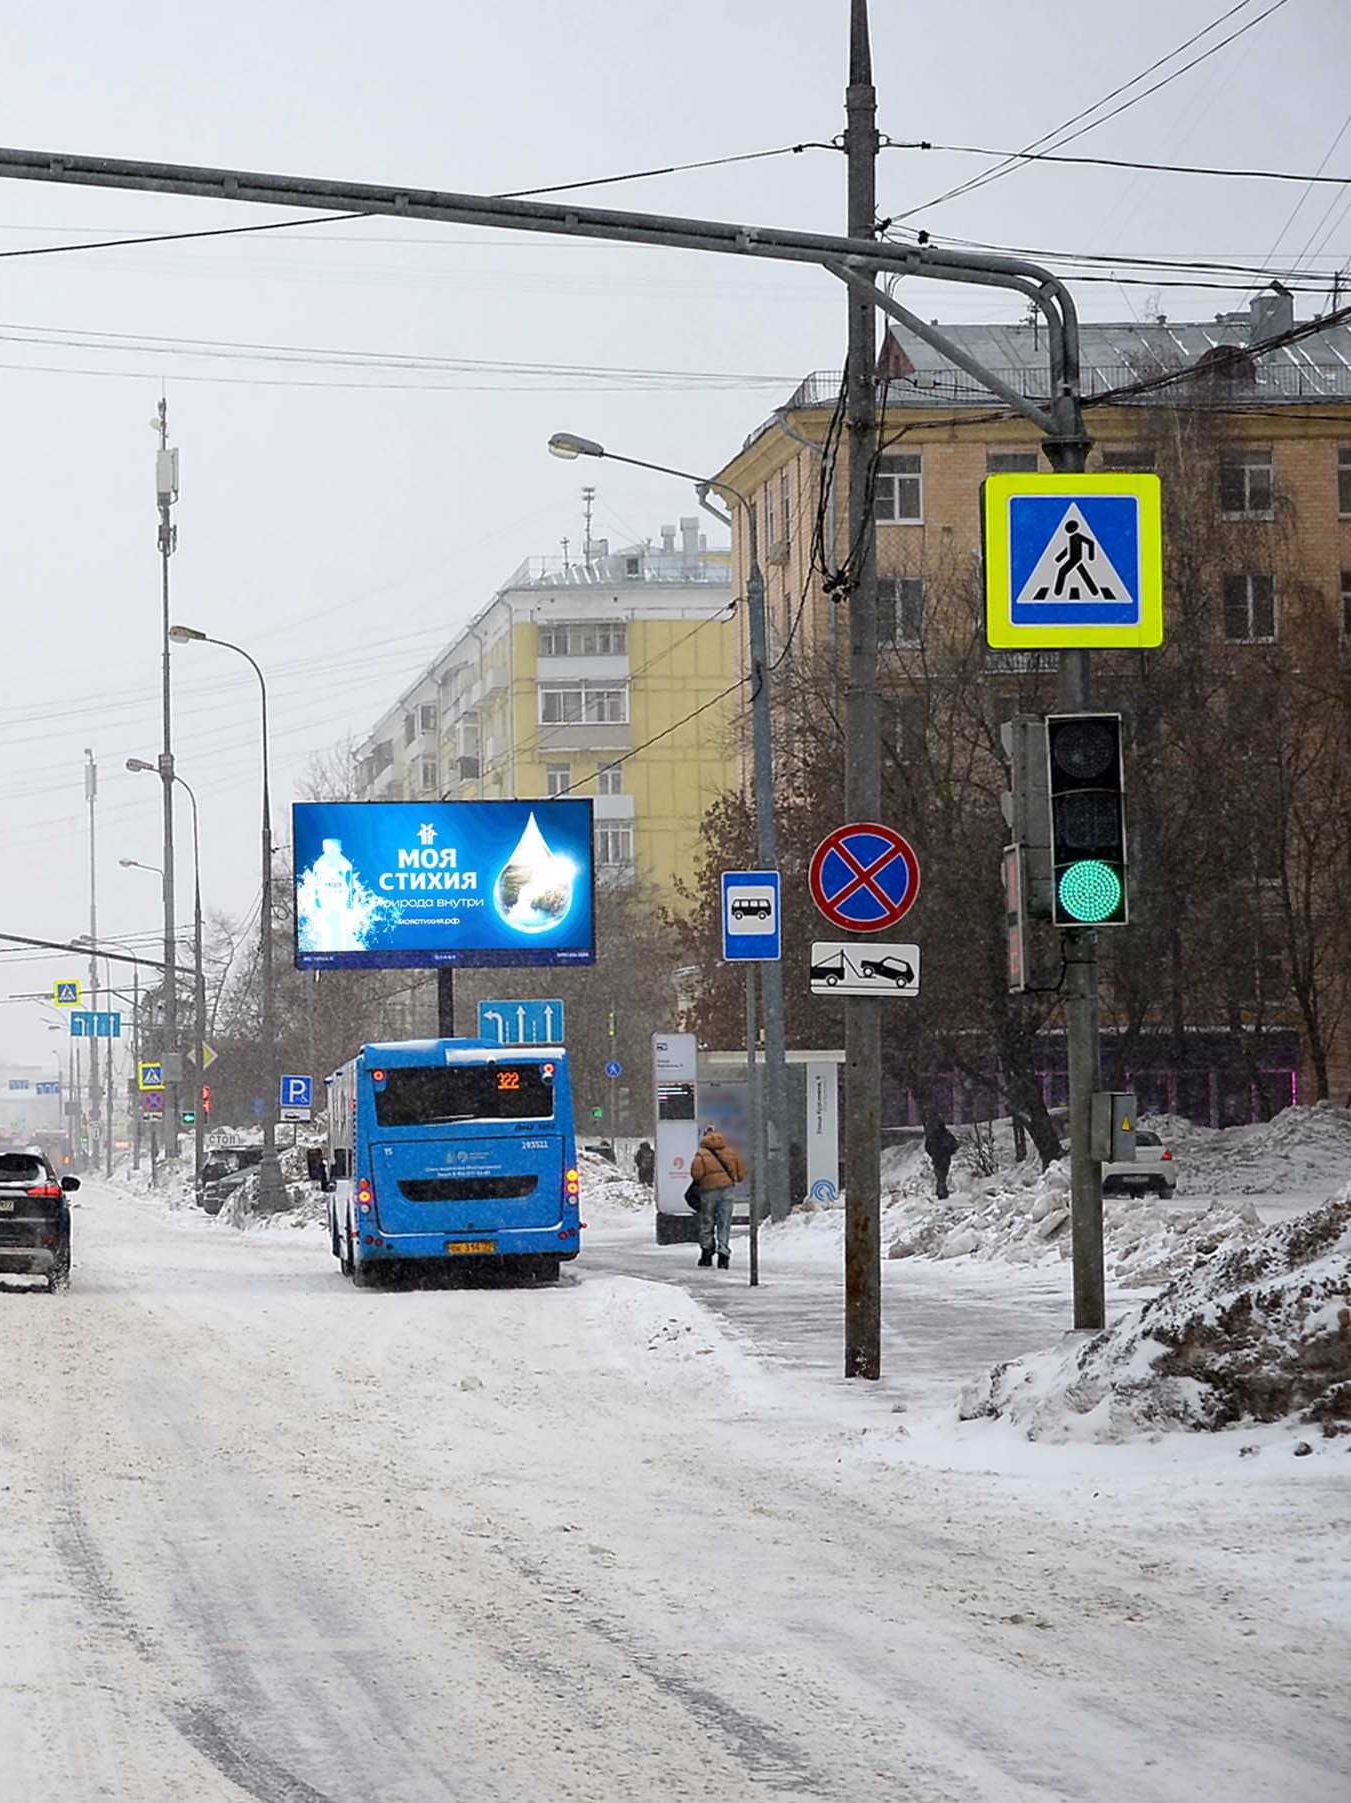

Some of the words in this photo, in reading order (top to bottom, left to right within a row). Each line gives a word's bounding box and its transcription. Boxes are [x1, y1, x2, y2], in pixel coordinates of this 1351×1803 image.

[398, 848, 457, 869] МОЯ
[379, 871, 477, 891] СТИХИЯ
[436, 897, 484, 910] внутри
[208, 1134, 236, 1145] СТОП
